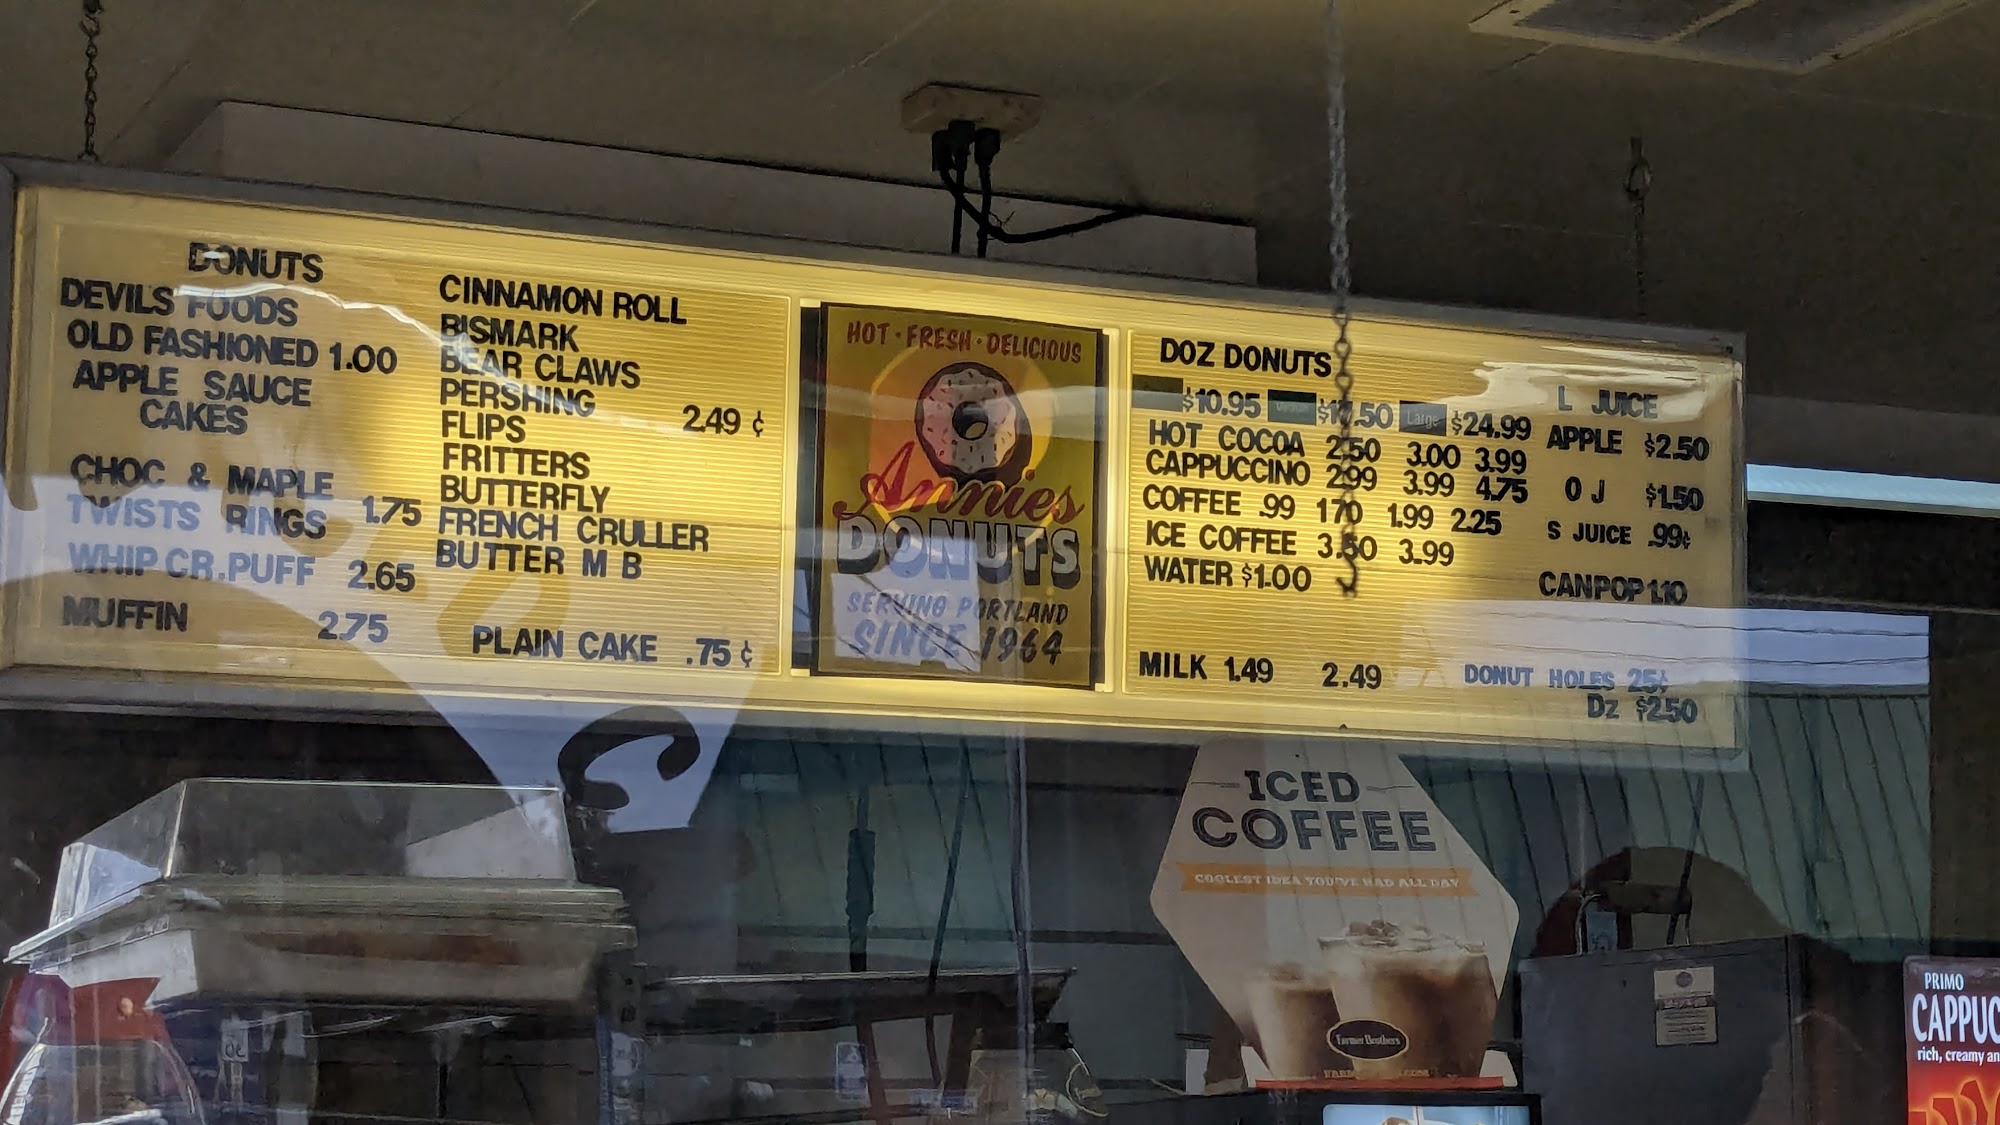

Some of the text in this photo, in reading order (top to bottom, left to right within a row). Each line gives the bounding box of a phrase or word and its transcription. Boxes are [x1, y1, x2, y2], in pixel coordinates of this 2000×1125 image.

[188, 242, 324, 283] DONUTS
[60, 277, 298, 327] DEVILS FOODS
[439, 274, 687, 325] CINNAMON ROLL
[67, 318, 397, 374] OLD FASHIONED 1.00
[440, 314, 579, 353] BISMARK
[847, 321, 1082, 363] HOT FRESH DELICIOUS
[440, 346, 641, 389] BEAR CLAWS
[1160, 337, 1332, 378] DOZ DONUTS
[72, 359, 312, 407] APPLE SAUCE
[439, 378, 596, 417] PERSHING
[1558, 385, 1659, 419] L JUICE
[140, 399, 248, 435] CAKES
[441, 410, 526, 443] FLIPS
[682, 404, 741, 435] 2.49
[1182, 387, 1262, 419] $10.95
[1407, 410, 1439, 430] Large
[1451, 409, 1532, 441] $24.99
[442, 443, 591, 480] FRITTERS
[1149, 419, 1203, 448] HOT
[1218, 424, 1305, 457] COCOA
[1406, 441, 1461, 470] 3.00
[1475, 447, 1527, 475] 3.99
[1546, 424, 1710, 461] APPLE $2.50
[70, 453, 334, 500] CHOC & MAPLE
[440, 475, 610, 514] BUTTERFLY
[832, 441, 1085, 524] Annies
[1146, 449, 1311, 487] CAPPUCCINO
[1403, 469, 1455, 498] 3.99
[1475, 475, 1529, 504] 4.75
[1591, 479, 1605, 504] J
[1645, 482, 1704, 512] $1.50
[66, 494, 422, 540] TWISTS RINGS 1.75
[438, 506, 709, 553] FRENCH CRULLER
[1142, 484, 1242, 516] COFFEE
[1387, 502, 1434, 530] 1.99
[1450, 508, 1503, 536] 2.25
[837, 515, 1081, 590] DONUTS
[1145, 519, 1187, 548] ICE
[1199, 524, 1297, 556] COFFEE
[1399, 538, 1455, 567] 3.99
[1547, 520, 1562, 541] S
[1572, 522, 1632, 545] JUICE
[68, 542, 158, 576] WHIP
[348, 559, 416, 592] 2.65
[435, 539, 642, 579] BUTTER M B
[1144, 555, 1312, 592] WATER $1.00
[63, 595, 389, 644] MUFFIN 2.75
[846, 591, 1068, 626] SERVING PORTLAND
[472, 625, 564, 658] PLAIN
[578, 630, 658, 662] CAKE
[854, 619, 1063, 665] SINCE 1964
[1139, 651, 1382, 690] MILK 1.49 2.49
[1464, 663, 1534, 688] DONUT
[1548, 668, 1615, 690] HOLES
[1244, 769, 1360, 803] ICED
[1192, 806, 1436, 851] COFFEE
[1194, 873, 1261, 885] COOLEST
[1398, 878, 1426, 888] ALL
[1431, 878, 1459, 888] DAY
[1925, 972, 1964, 990] PRIMO
[1912, 993, 2000, 1044] CAPPUC
[1917, 1046, 1942, 1063] rich,
[1945, 1050, 1983, 1066] creamy
